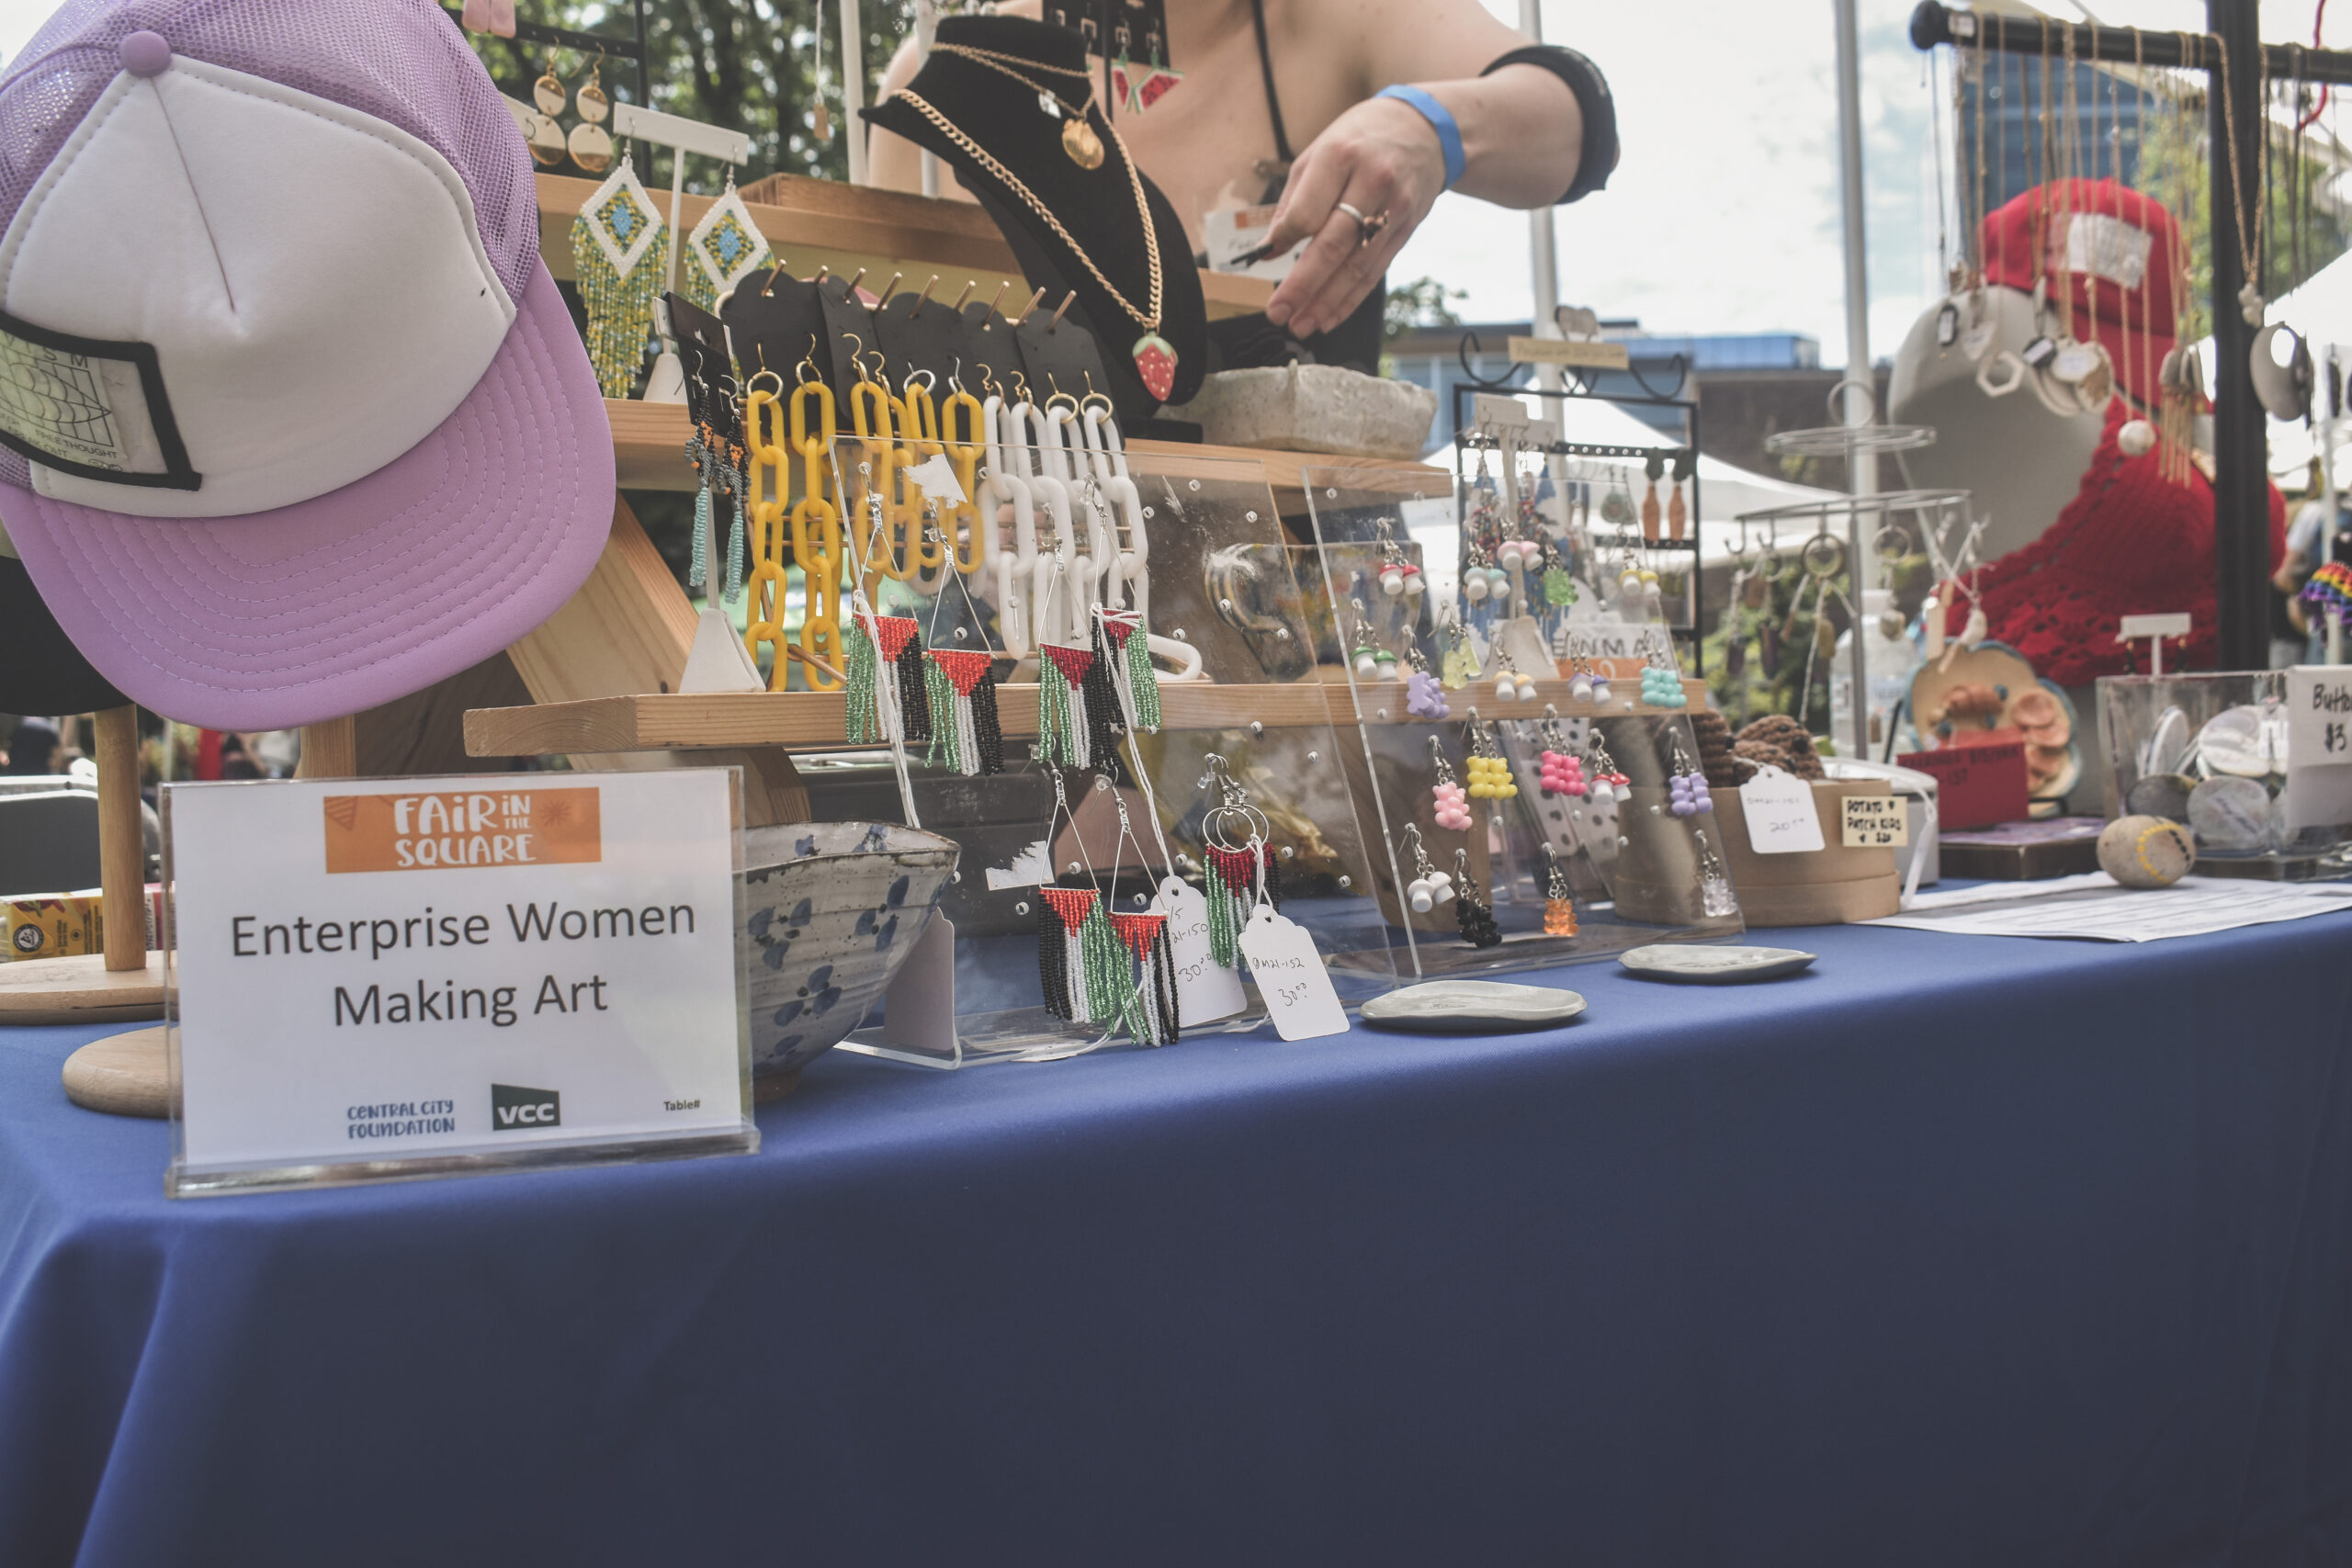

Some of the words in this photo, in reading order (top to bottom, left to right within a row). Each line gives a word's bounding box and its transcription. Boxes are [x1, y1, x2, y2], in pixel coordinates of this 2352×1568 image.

[63, 440, 118, 459] THOUGHT
[2312, 682, 2352, 714] Butto
[2324, 722, 2346, 753] $3
[1847, 799, 1883, 814] POTATO
[503, 818, 532, 829] THE
[1847, 816, 1876, 831] PATCH
[1879, 818, 1902, 831] KIDS
[394, 834, 537, 868] SQUARE
[232, 908, 491, 961] Enterprise
[506, 901, 696, 943] Women
[334, 979, 518, 1028] Making
[533, 975, 609, 1015] Art
[497, 1102, 555, 1125] VCC
[663, 1099, 701, 1111] Table#
[348, 1117, 456, 1139] FOUNDATION
